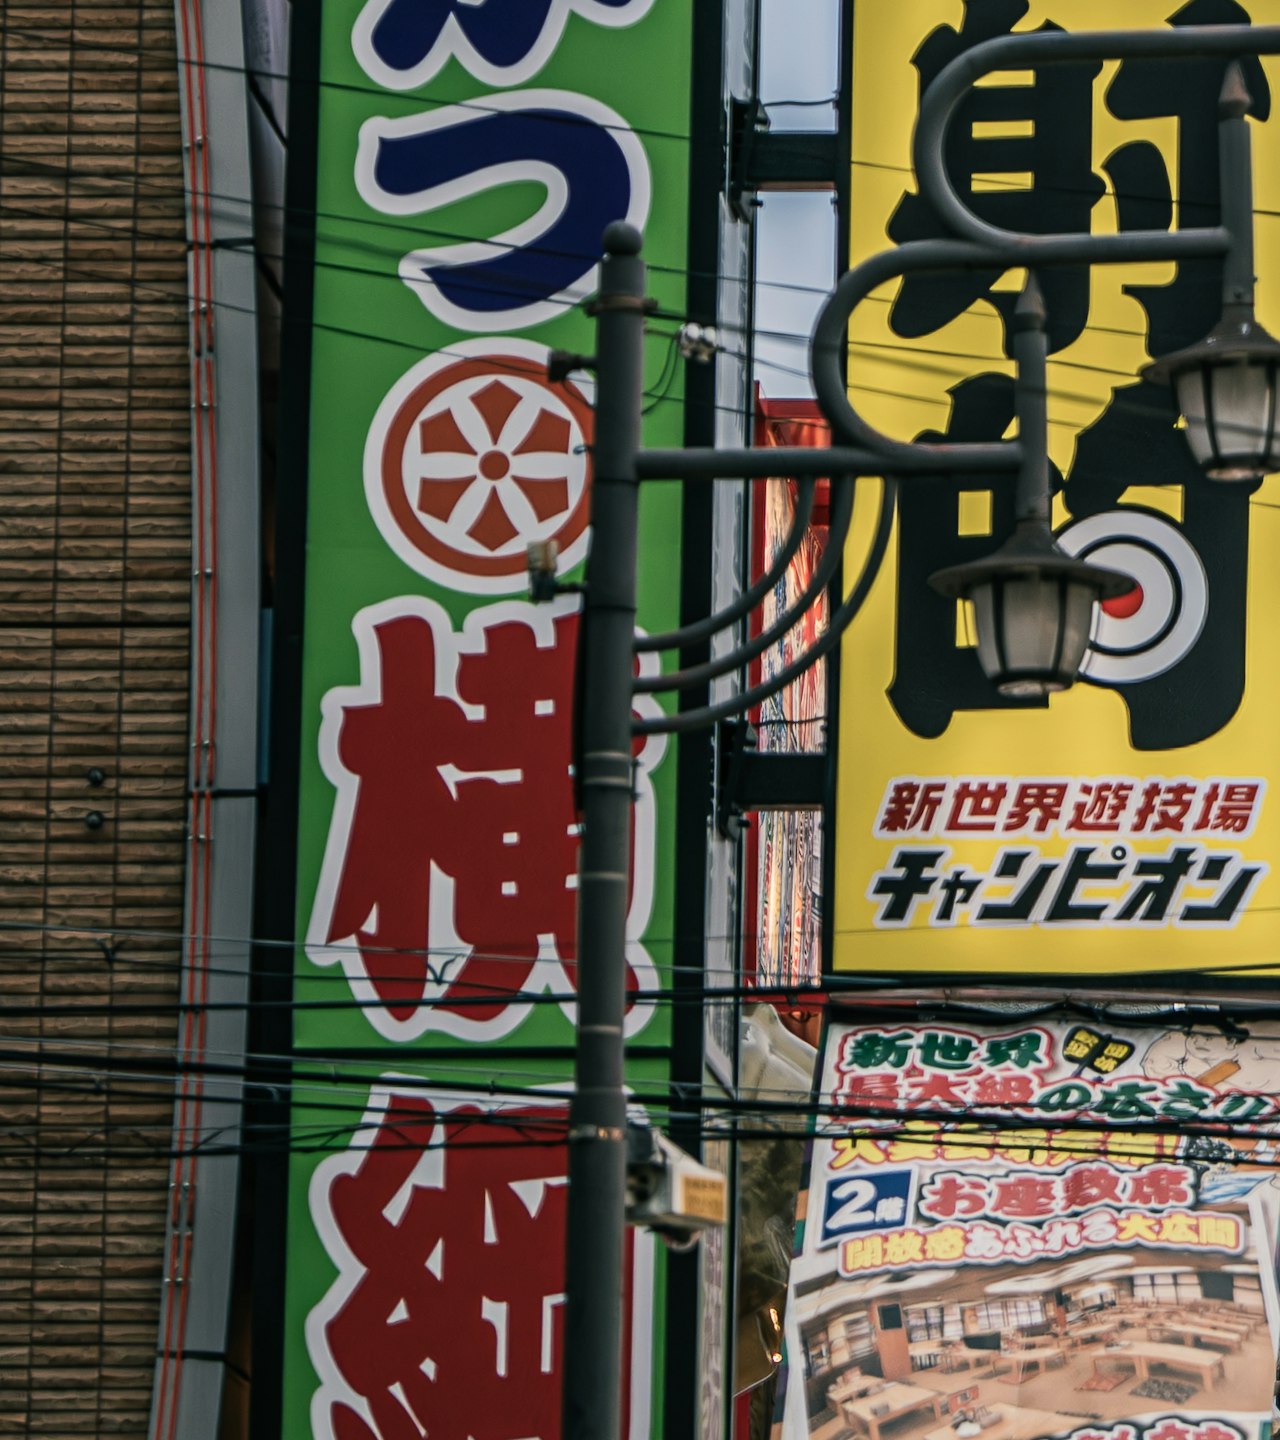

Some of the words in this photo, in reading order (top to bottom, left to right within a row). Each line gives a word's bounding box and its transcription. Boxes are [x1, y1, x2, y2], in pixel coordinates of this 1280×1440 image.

[879, 778, 1263, 838] 新世界遊技場
[872, 848, 1265, 928] チャンピオン
[846, 1031, 1044, 1069] 新世界
[926, 1164, 1191, 1218] お座敷席
